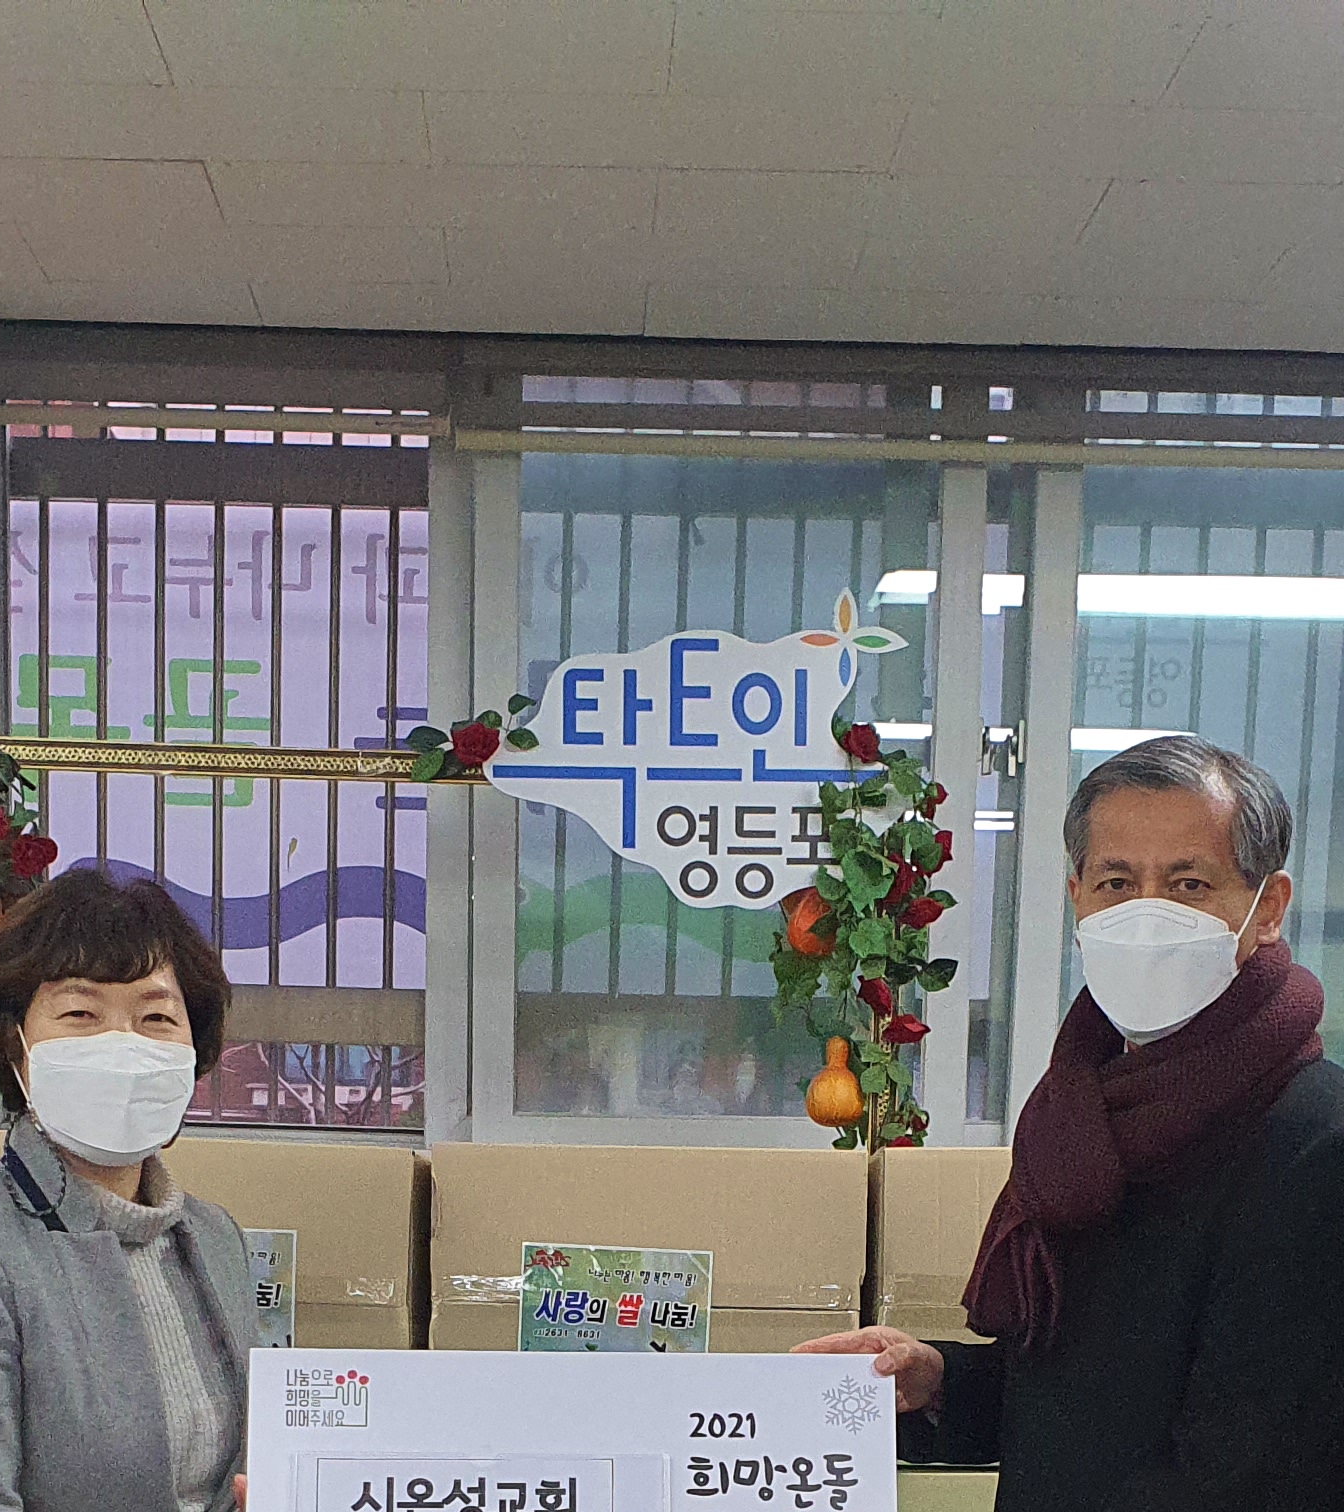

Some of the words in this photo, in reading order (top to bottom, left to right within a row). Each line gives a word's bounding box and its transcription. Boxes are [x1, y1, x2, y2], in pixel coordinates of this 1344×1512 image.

[535, 1289, 608, 1325] 사랑의
[616, 1292, 645, 1327] 쌀
[650, 1301, 698, 1329] 나눔!
[689, 1412, 756, 1439] 2021
[686, 1454, 859, 1511] 희망온돌
